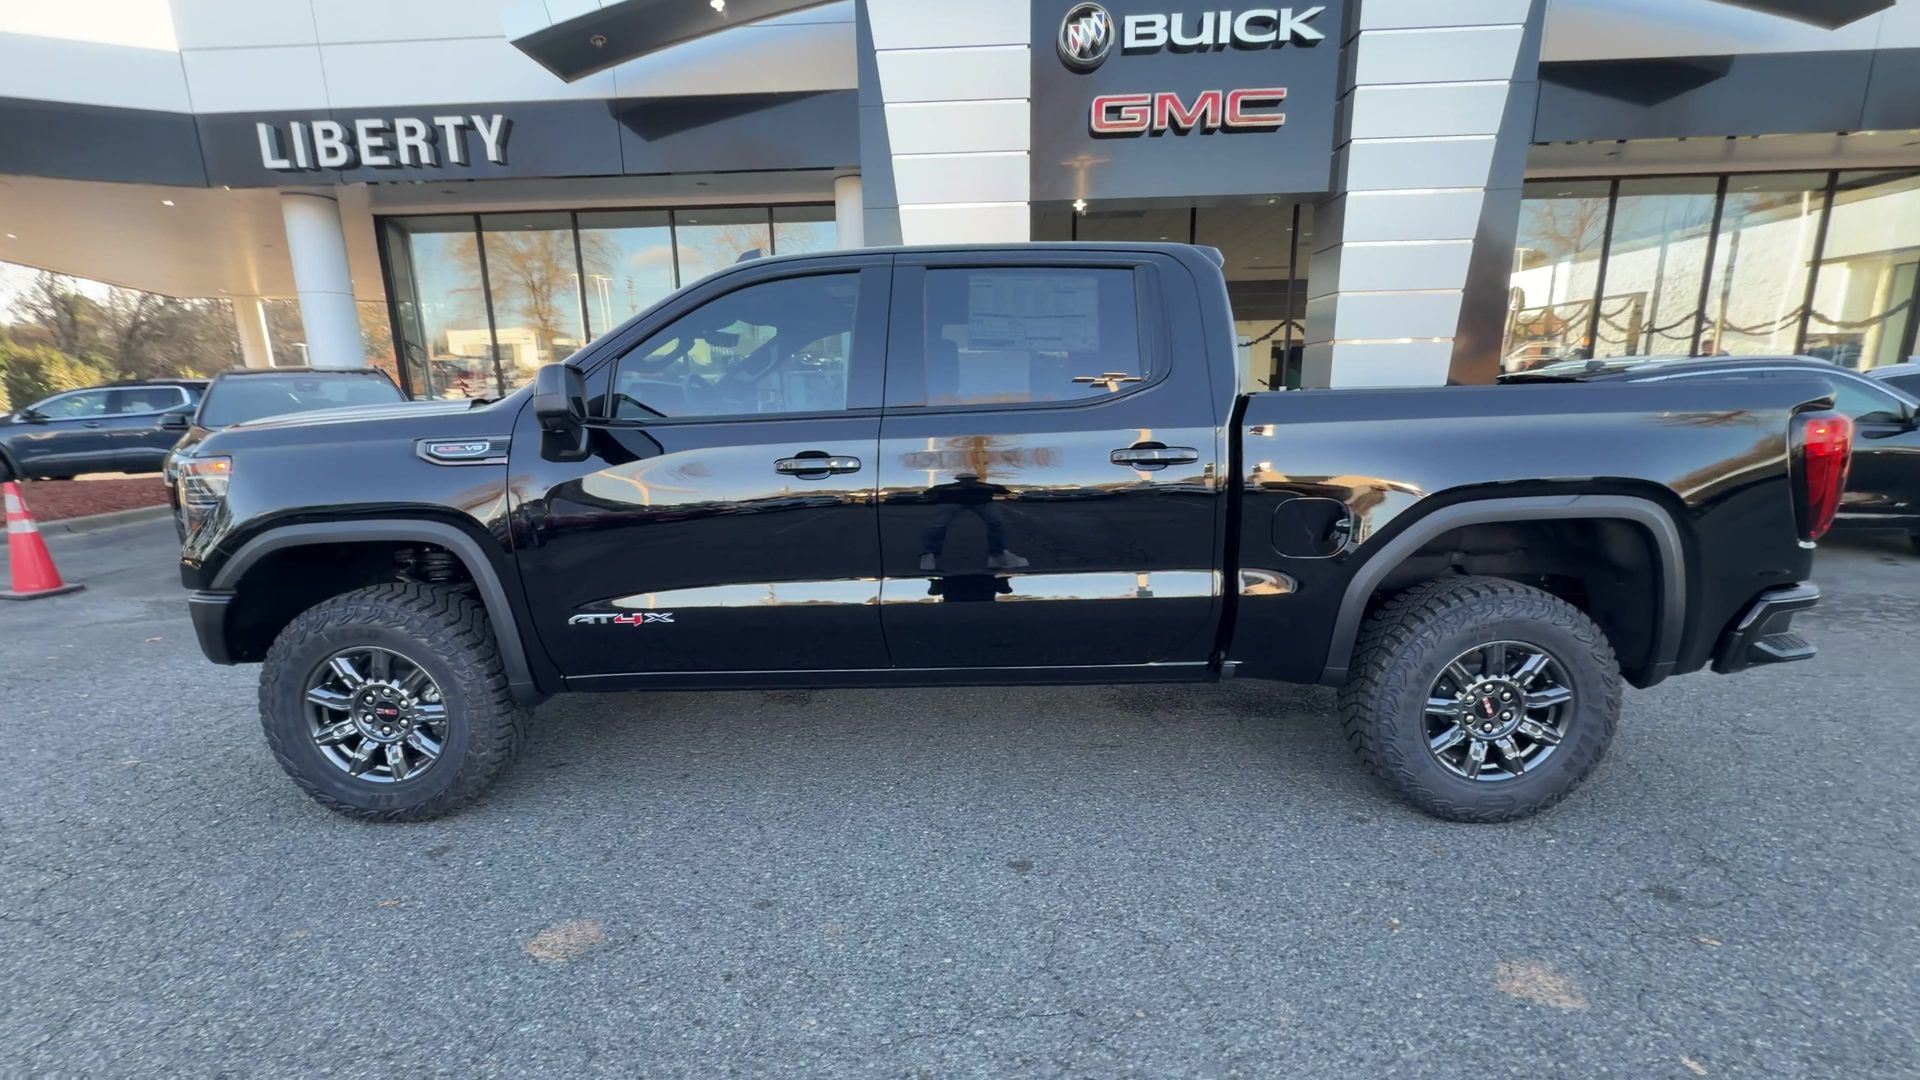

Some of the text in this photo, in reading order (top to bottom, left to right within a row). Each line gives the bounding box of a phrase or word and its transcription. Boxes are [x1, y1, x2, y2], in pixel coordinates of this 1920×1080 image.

[1124, 6, 1326, 48] BUICK
[1091, 87, 1288, 133] GMC
[256, 114, 503, 169] LIBERTY
[568, 612, 675, 626] AT4X
